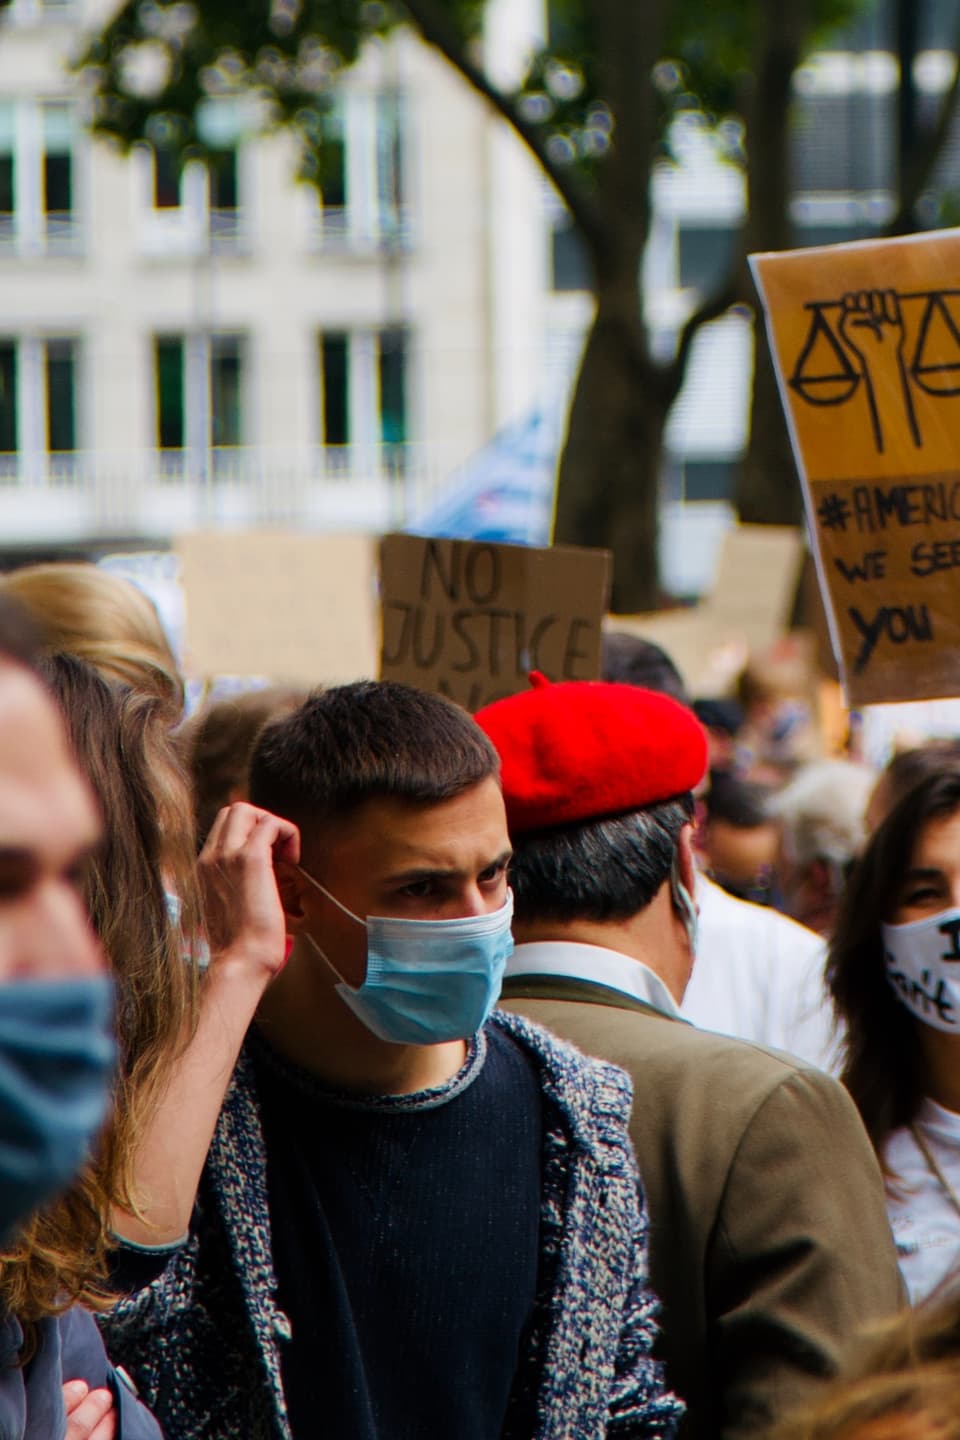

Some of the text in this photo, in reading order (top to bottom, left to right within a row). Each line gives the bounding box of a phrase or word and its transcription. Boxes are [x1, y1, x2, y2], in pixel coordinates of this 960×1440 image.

[420, 538, 502, 605] NO
[834, 547, 888, 584] WE
[381, 597, 594, 683] JUSTICE
